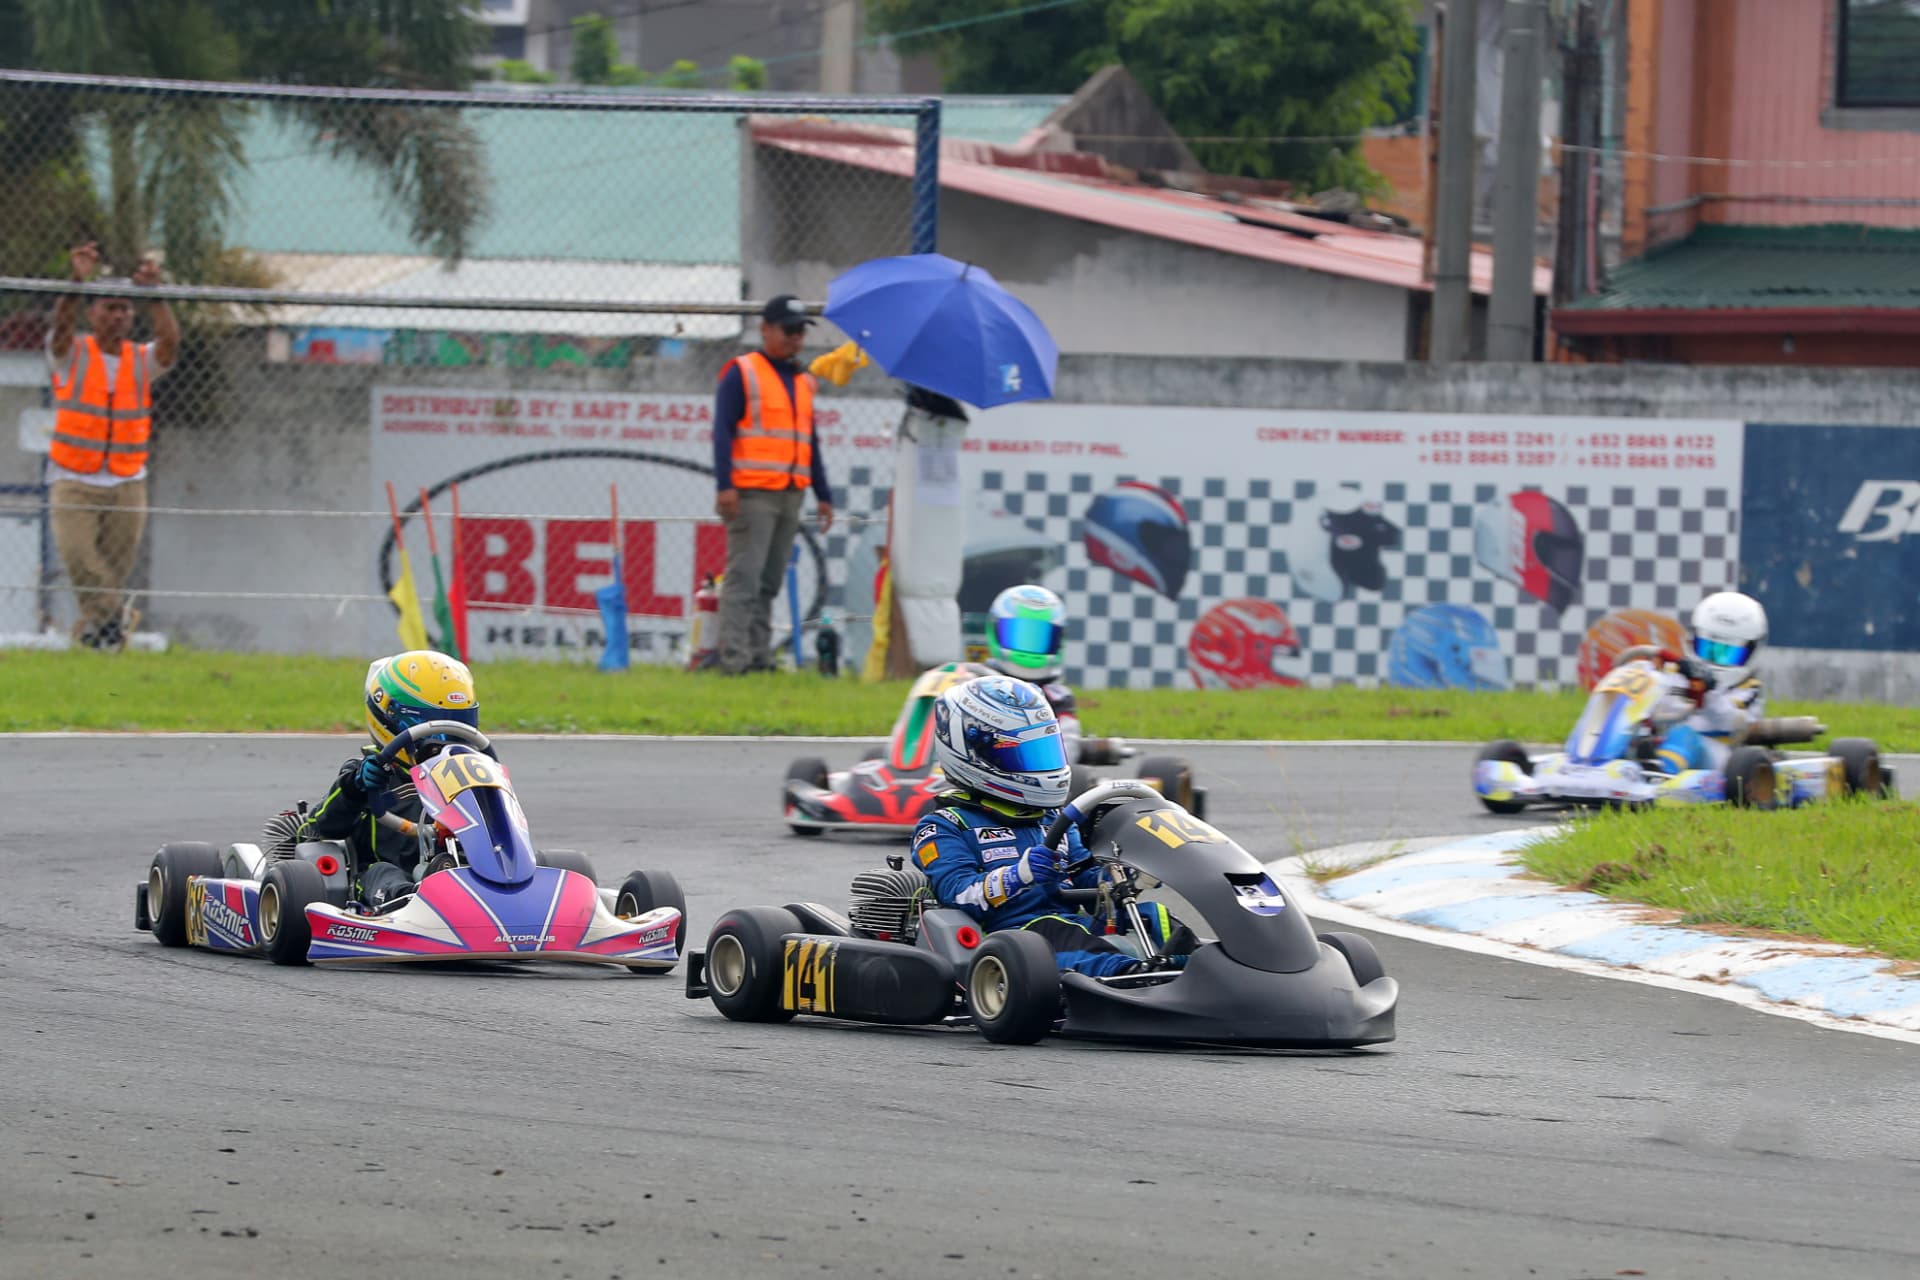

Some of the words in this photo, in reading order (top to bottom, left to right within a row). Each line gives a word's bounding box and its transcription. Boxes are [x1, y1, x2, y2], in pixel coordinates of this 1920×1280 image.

[638, 403, 711, 422] PLAZA
[1256, 427, 1330, 442] CONTACT
[441, 756, 494, 787] 16
[326, 923, 379, 942] KOSMIC
[494, 934, 556, 943] AUTOPLUS
